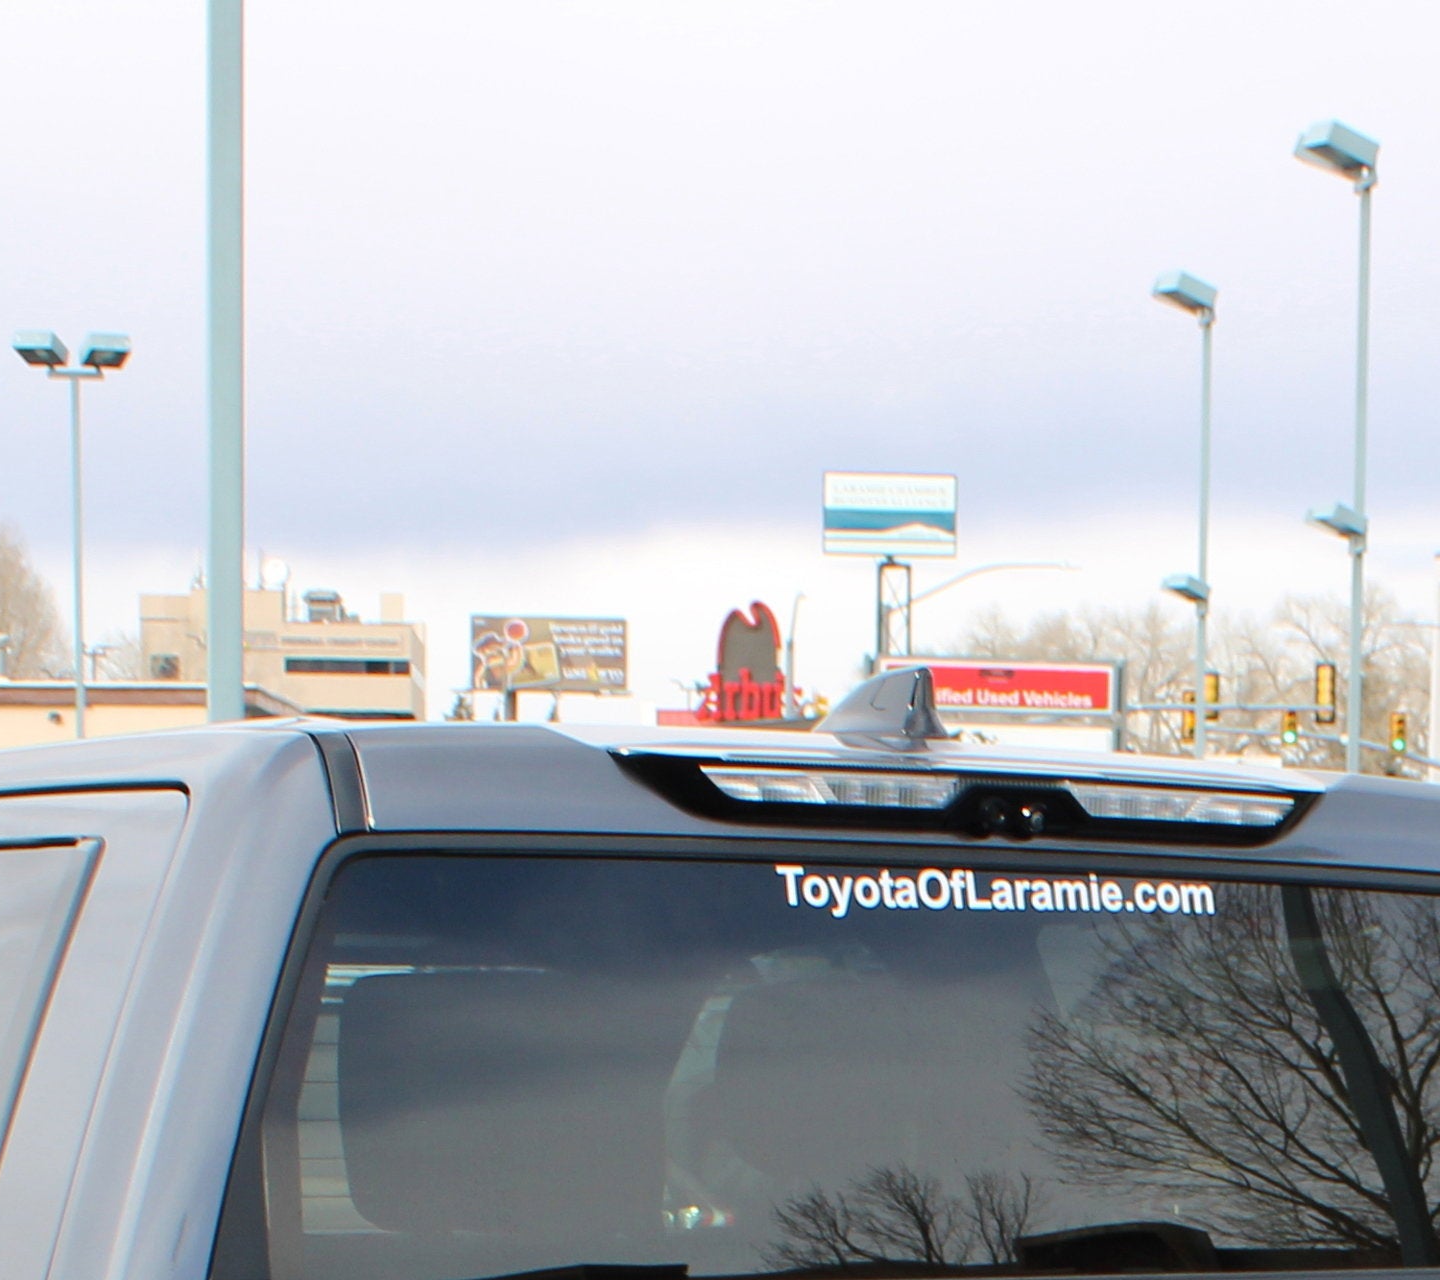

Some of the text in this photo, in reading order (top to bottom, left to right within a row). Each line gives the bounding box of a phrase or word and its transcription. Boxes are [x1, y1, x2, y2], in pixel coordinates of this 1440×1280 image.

[977, 689, 1020, 706] Used
[1023, 690, 1093, 708] Vehicles
[774, 864, 1217, 918] ToyotaOfLaramie.com
